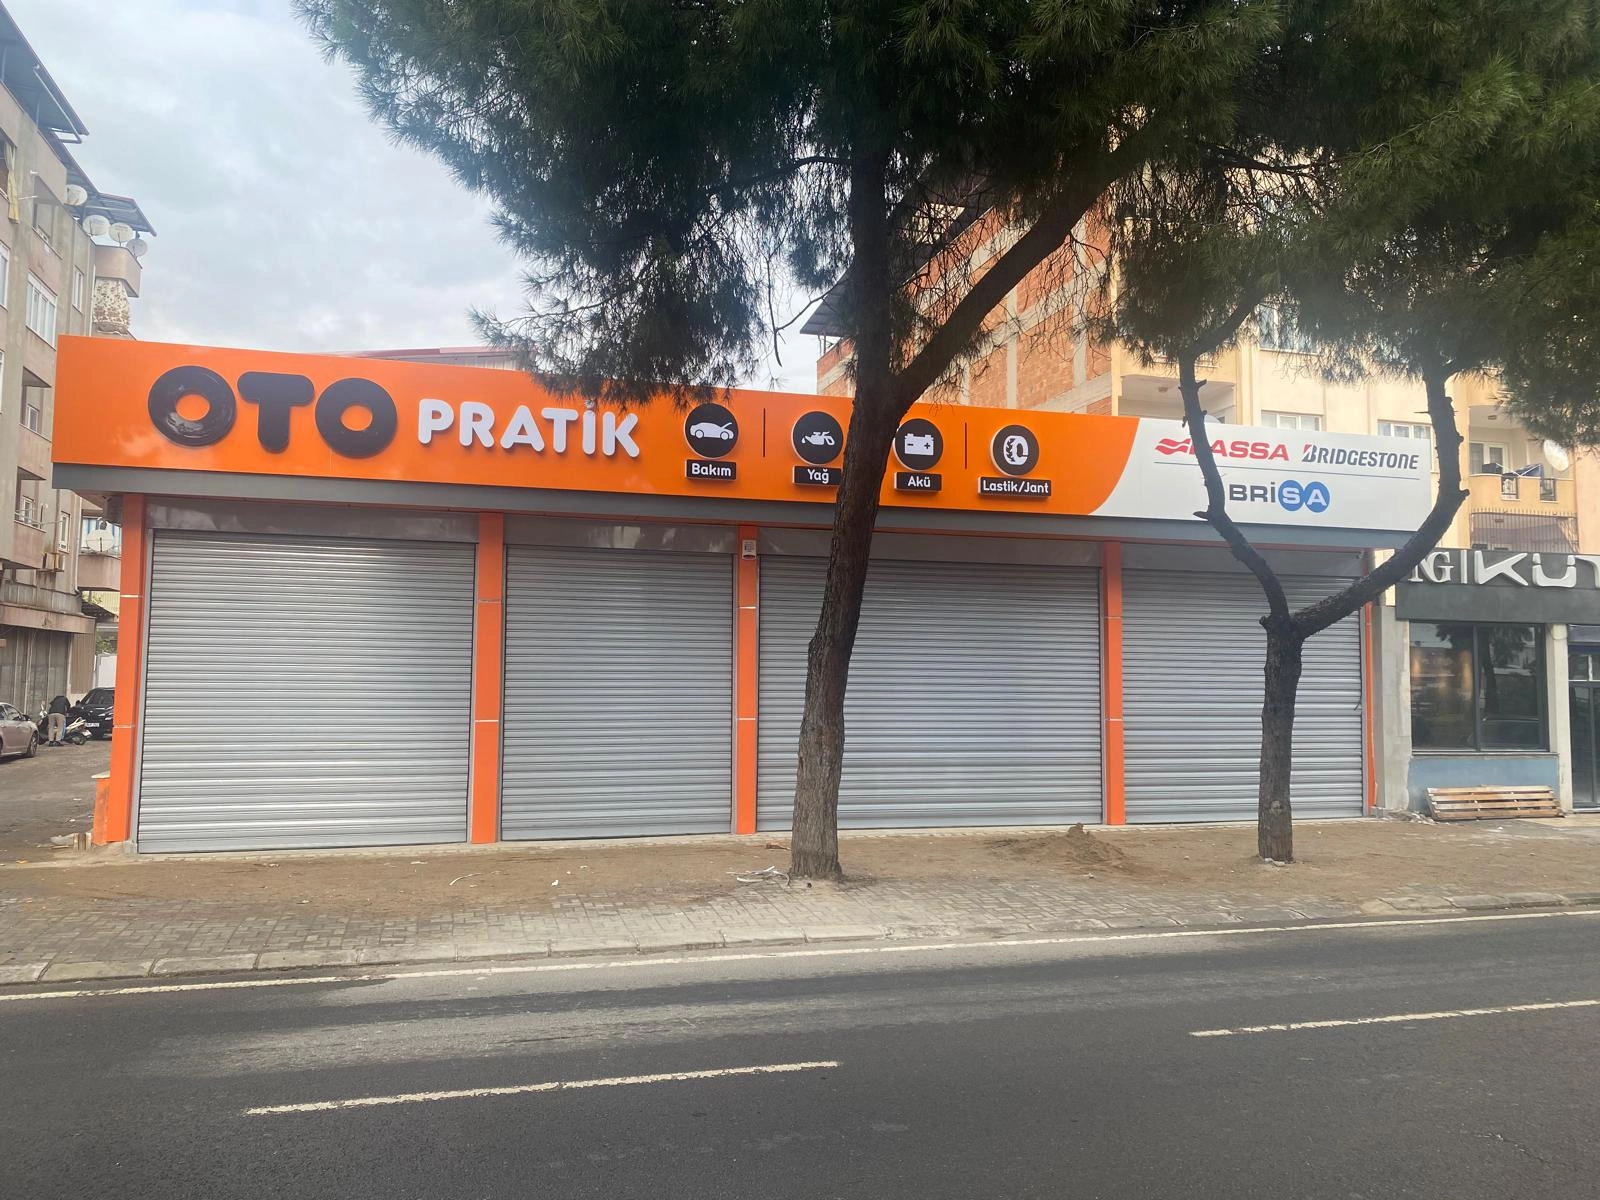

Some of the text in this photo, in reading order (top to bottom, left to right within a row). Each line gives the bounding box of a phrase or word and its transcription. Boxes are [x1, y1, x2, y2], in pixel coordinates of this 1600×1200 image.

[148, 365, 398, 458] OTO
[1189, 438, 1290, 461] ASSA
[1302, 444, 1420, 470] BRIDGESTONE
[691, 462, 732, 477] Bakım
[807, 469, 829, 484] Yağ
[907, 475, 931, 488] Akü
[982, 479, 1049, 493] Lastik/Jant
